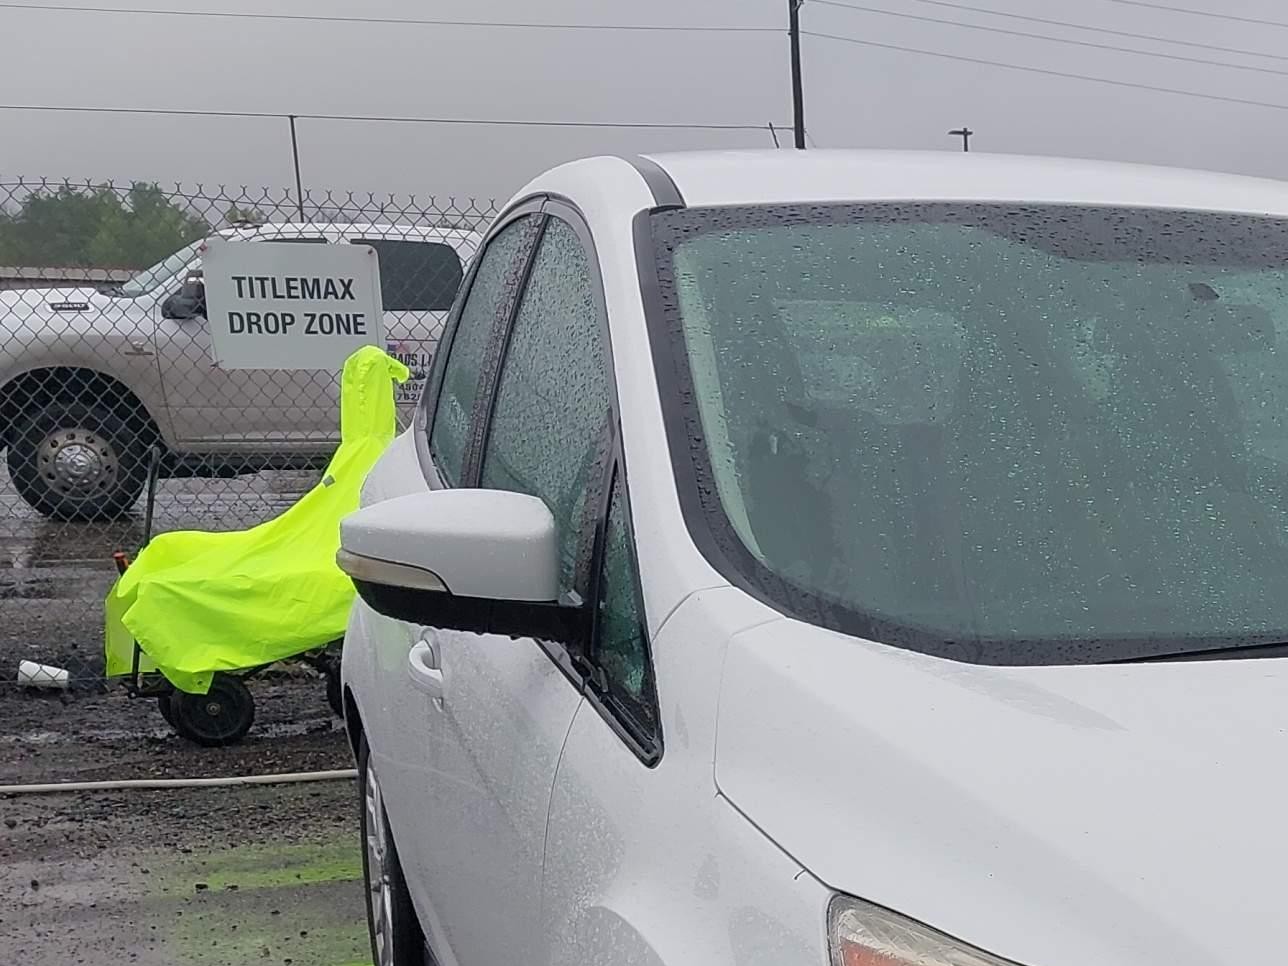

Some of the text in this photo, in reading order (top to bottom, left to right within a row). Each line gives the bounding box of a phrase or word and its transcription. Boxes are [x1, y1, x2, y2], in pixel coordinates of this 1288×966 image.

[231, 276, 355, 300] TITLEMAX
[228, 311, 367, 335] DROP ZONE
